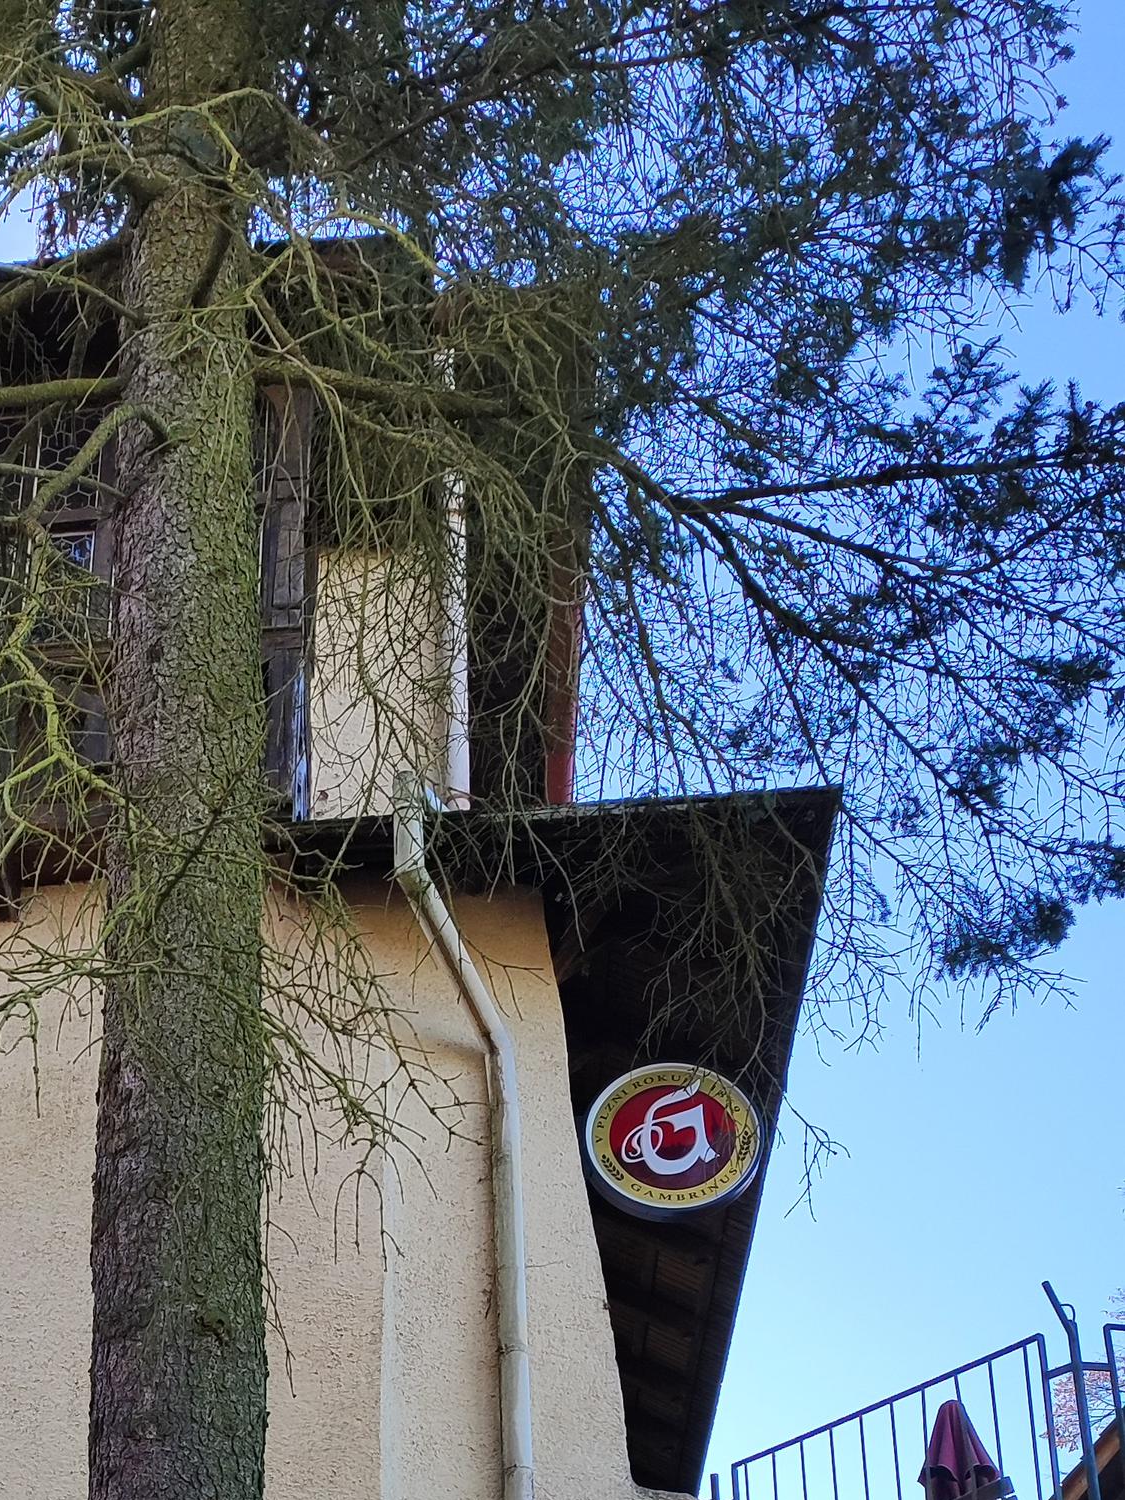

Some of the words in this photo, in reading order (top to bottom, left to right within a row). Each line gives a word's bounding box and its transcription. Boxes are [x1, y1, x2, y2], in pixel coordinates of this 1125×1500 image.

[595, 1136, 604, 1144] V
[632, 1074, 681, 1089] ROKU
[630, 1167, 738, 1201] GAMBRINUS
